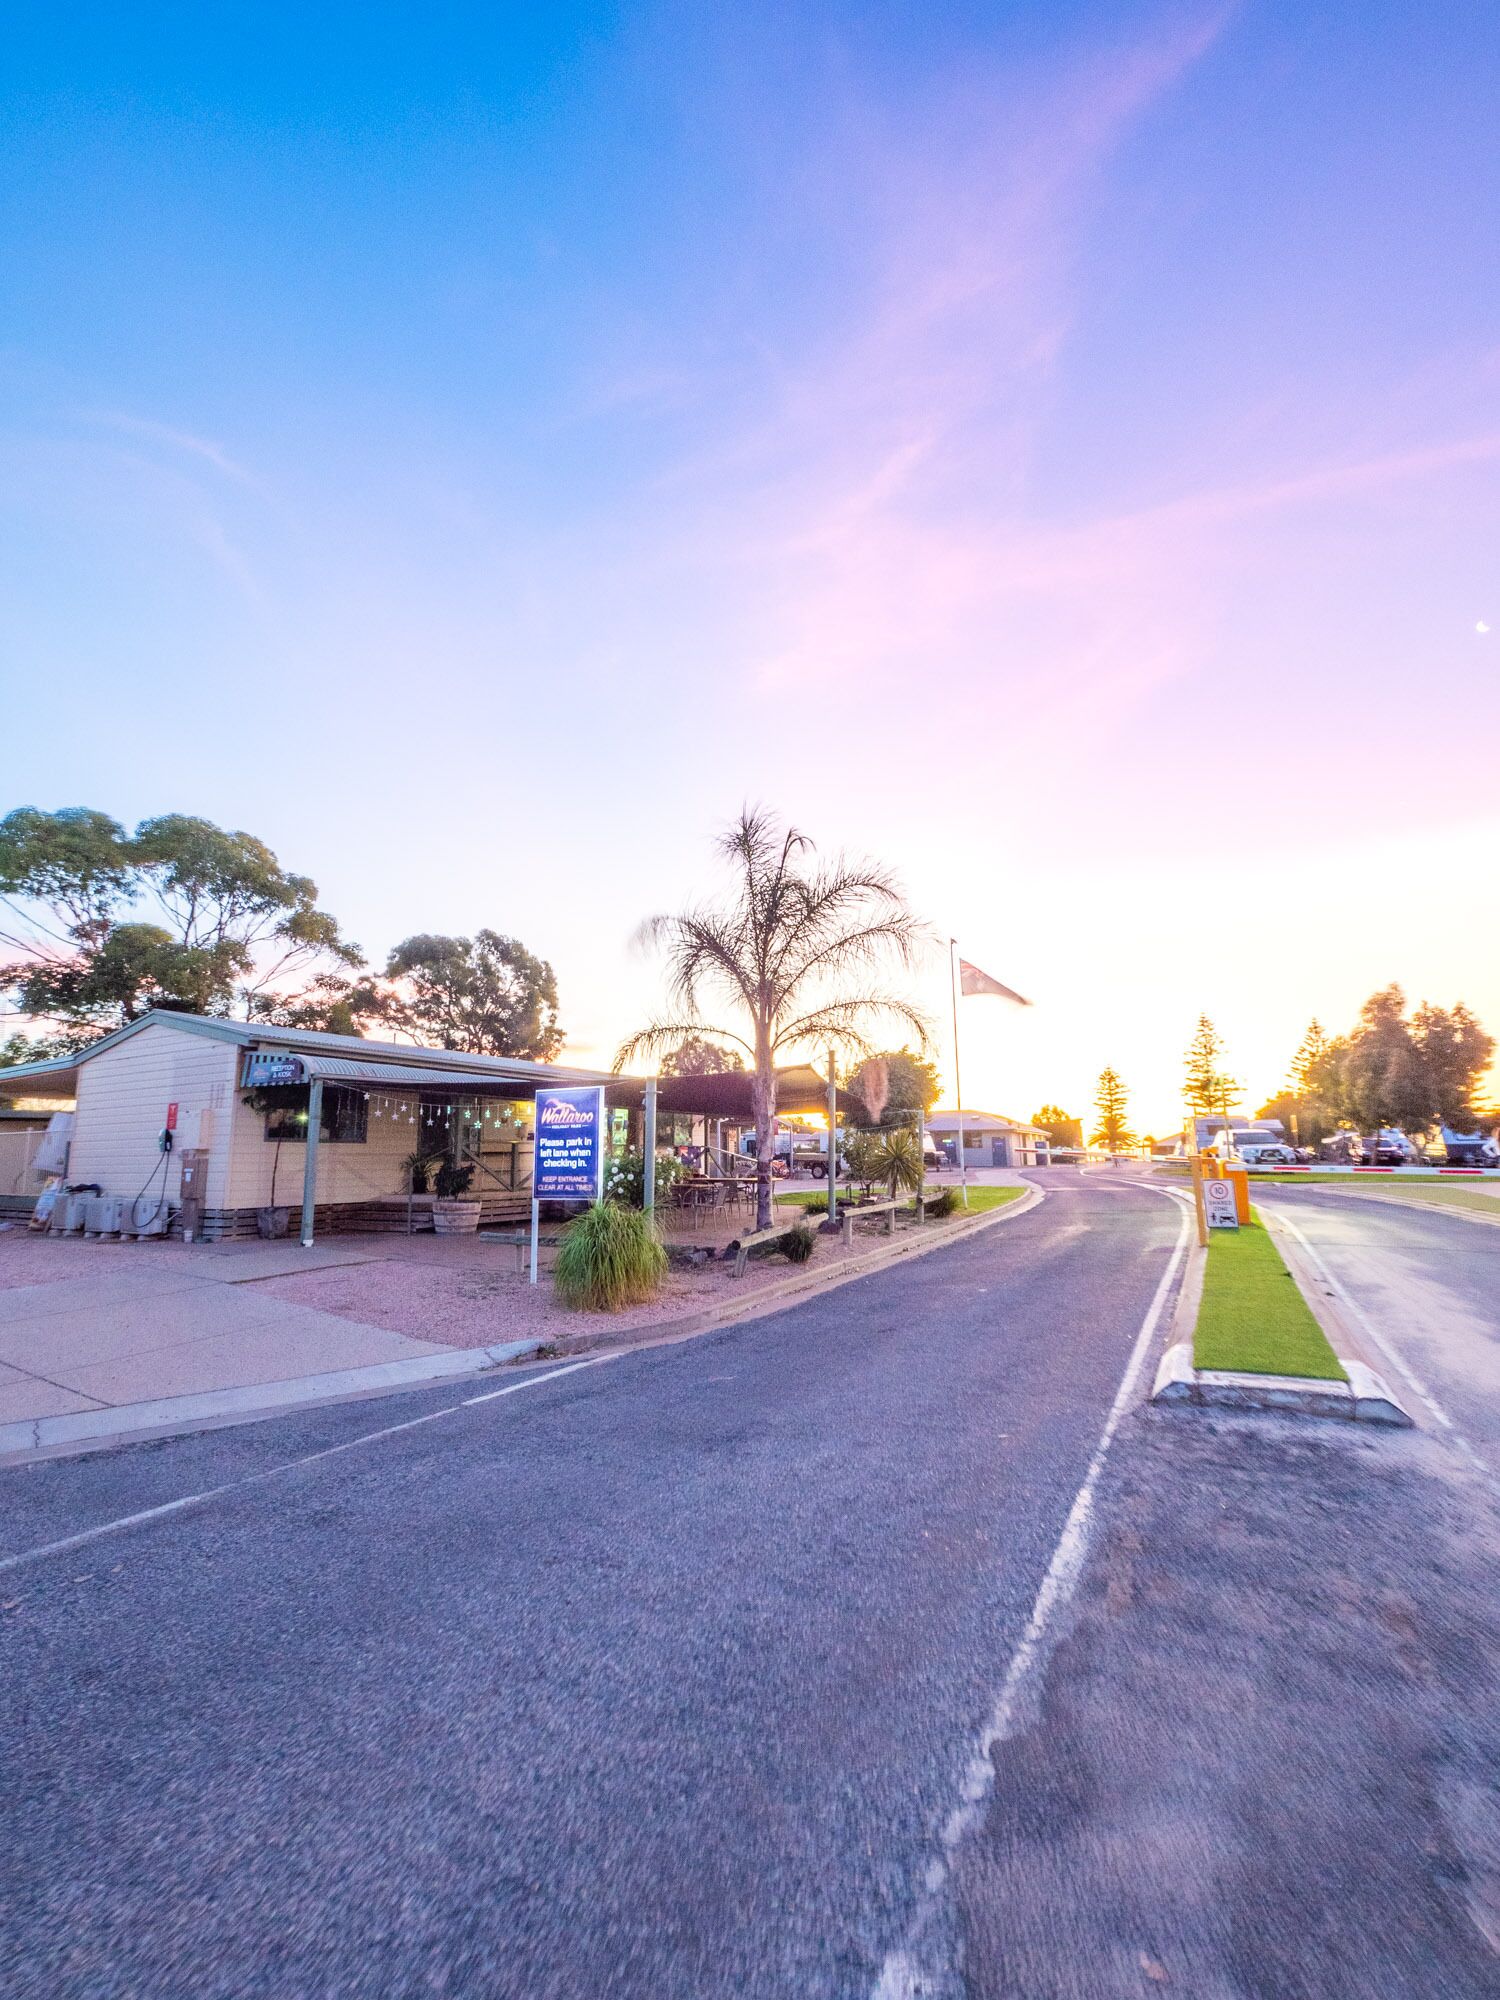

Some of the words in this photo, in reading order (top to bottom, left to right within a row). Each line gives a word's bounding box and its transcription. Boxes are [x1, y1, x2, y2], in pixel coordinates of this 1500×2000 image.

[541, 1107, 594, 1124] Wallaroo
[540, 1138, 565, 1147] Please
[565, 1136, 583, 1148] park
[584, 1137, 592, 1146] in
[540, 1148, 553, 1158] left
[553, 1148, 569, 1157] lane
[570, 1148, 591, 1157] when
[543, 1158, 577, 1169] checking
[577, 1158, 588, 1167] in.
[542, 1175, 558, 1183] KEEP
[558, 1175, 588, 1183] ENTRANCE
